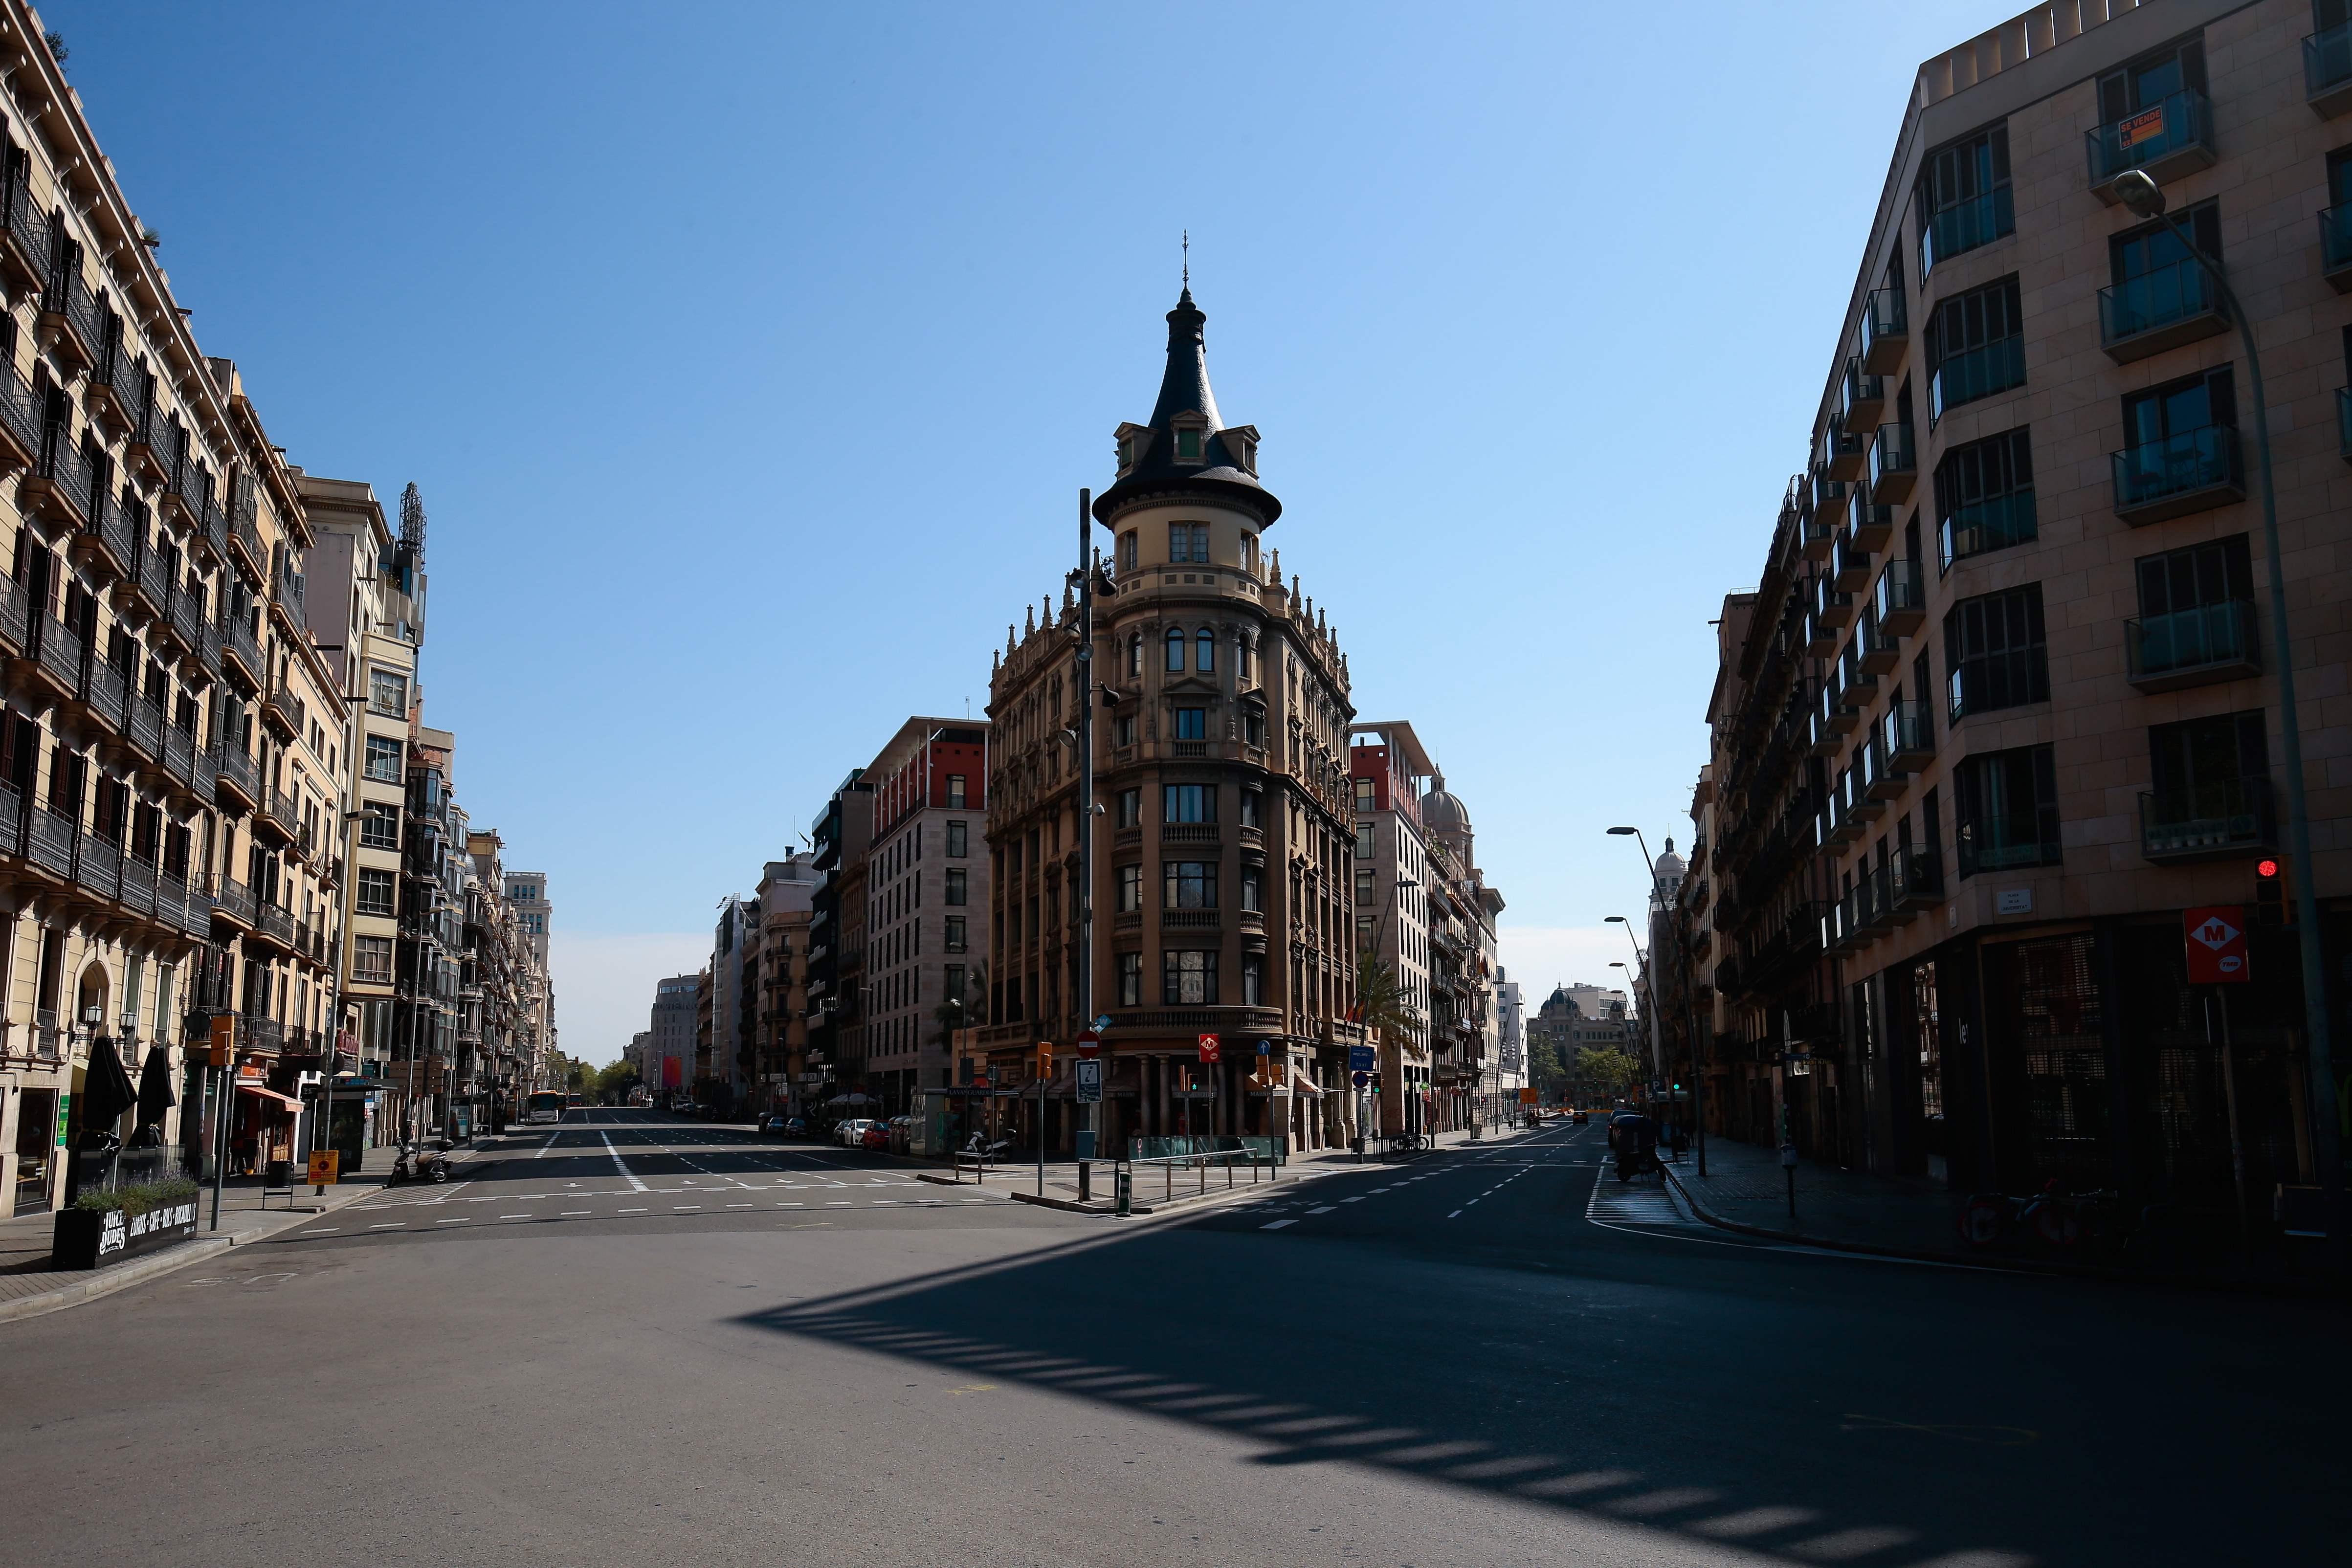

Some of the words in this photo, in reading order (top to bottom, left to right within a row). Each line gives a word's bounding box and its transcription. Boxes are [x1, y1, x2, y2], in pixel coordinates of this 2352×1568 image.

[2121, 122, 2131, 133] SE
[2133, 110, 2160, 127] VENDE
[2204, 925, 2225, 942] M
[1653, 1081, 1660, 1089] P
[105, 1210, 125, 1232] JUICE
[130, 1213, 147, 1237] ZUMOS
[149, 1210, 160, 1232] CAFE
[162, 1207, 173, 1229] BOLS
[99, 1226, 126, 1256] DUDES
